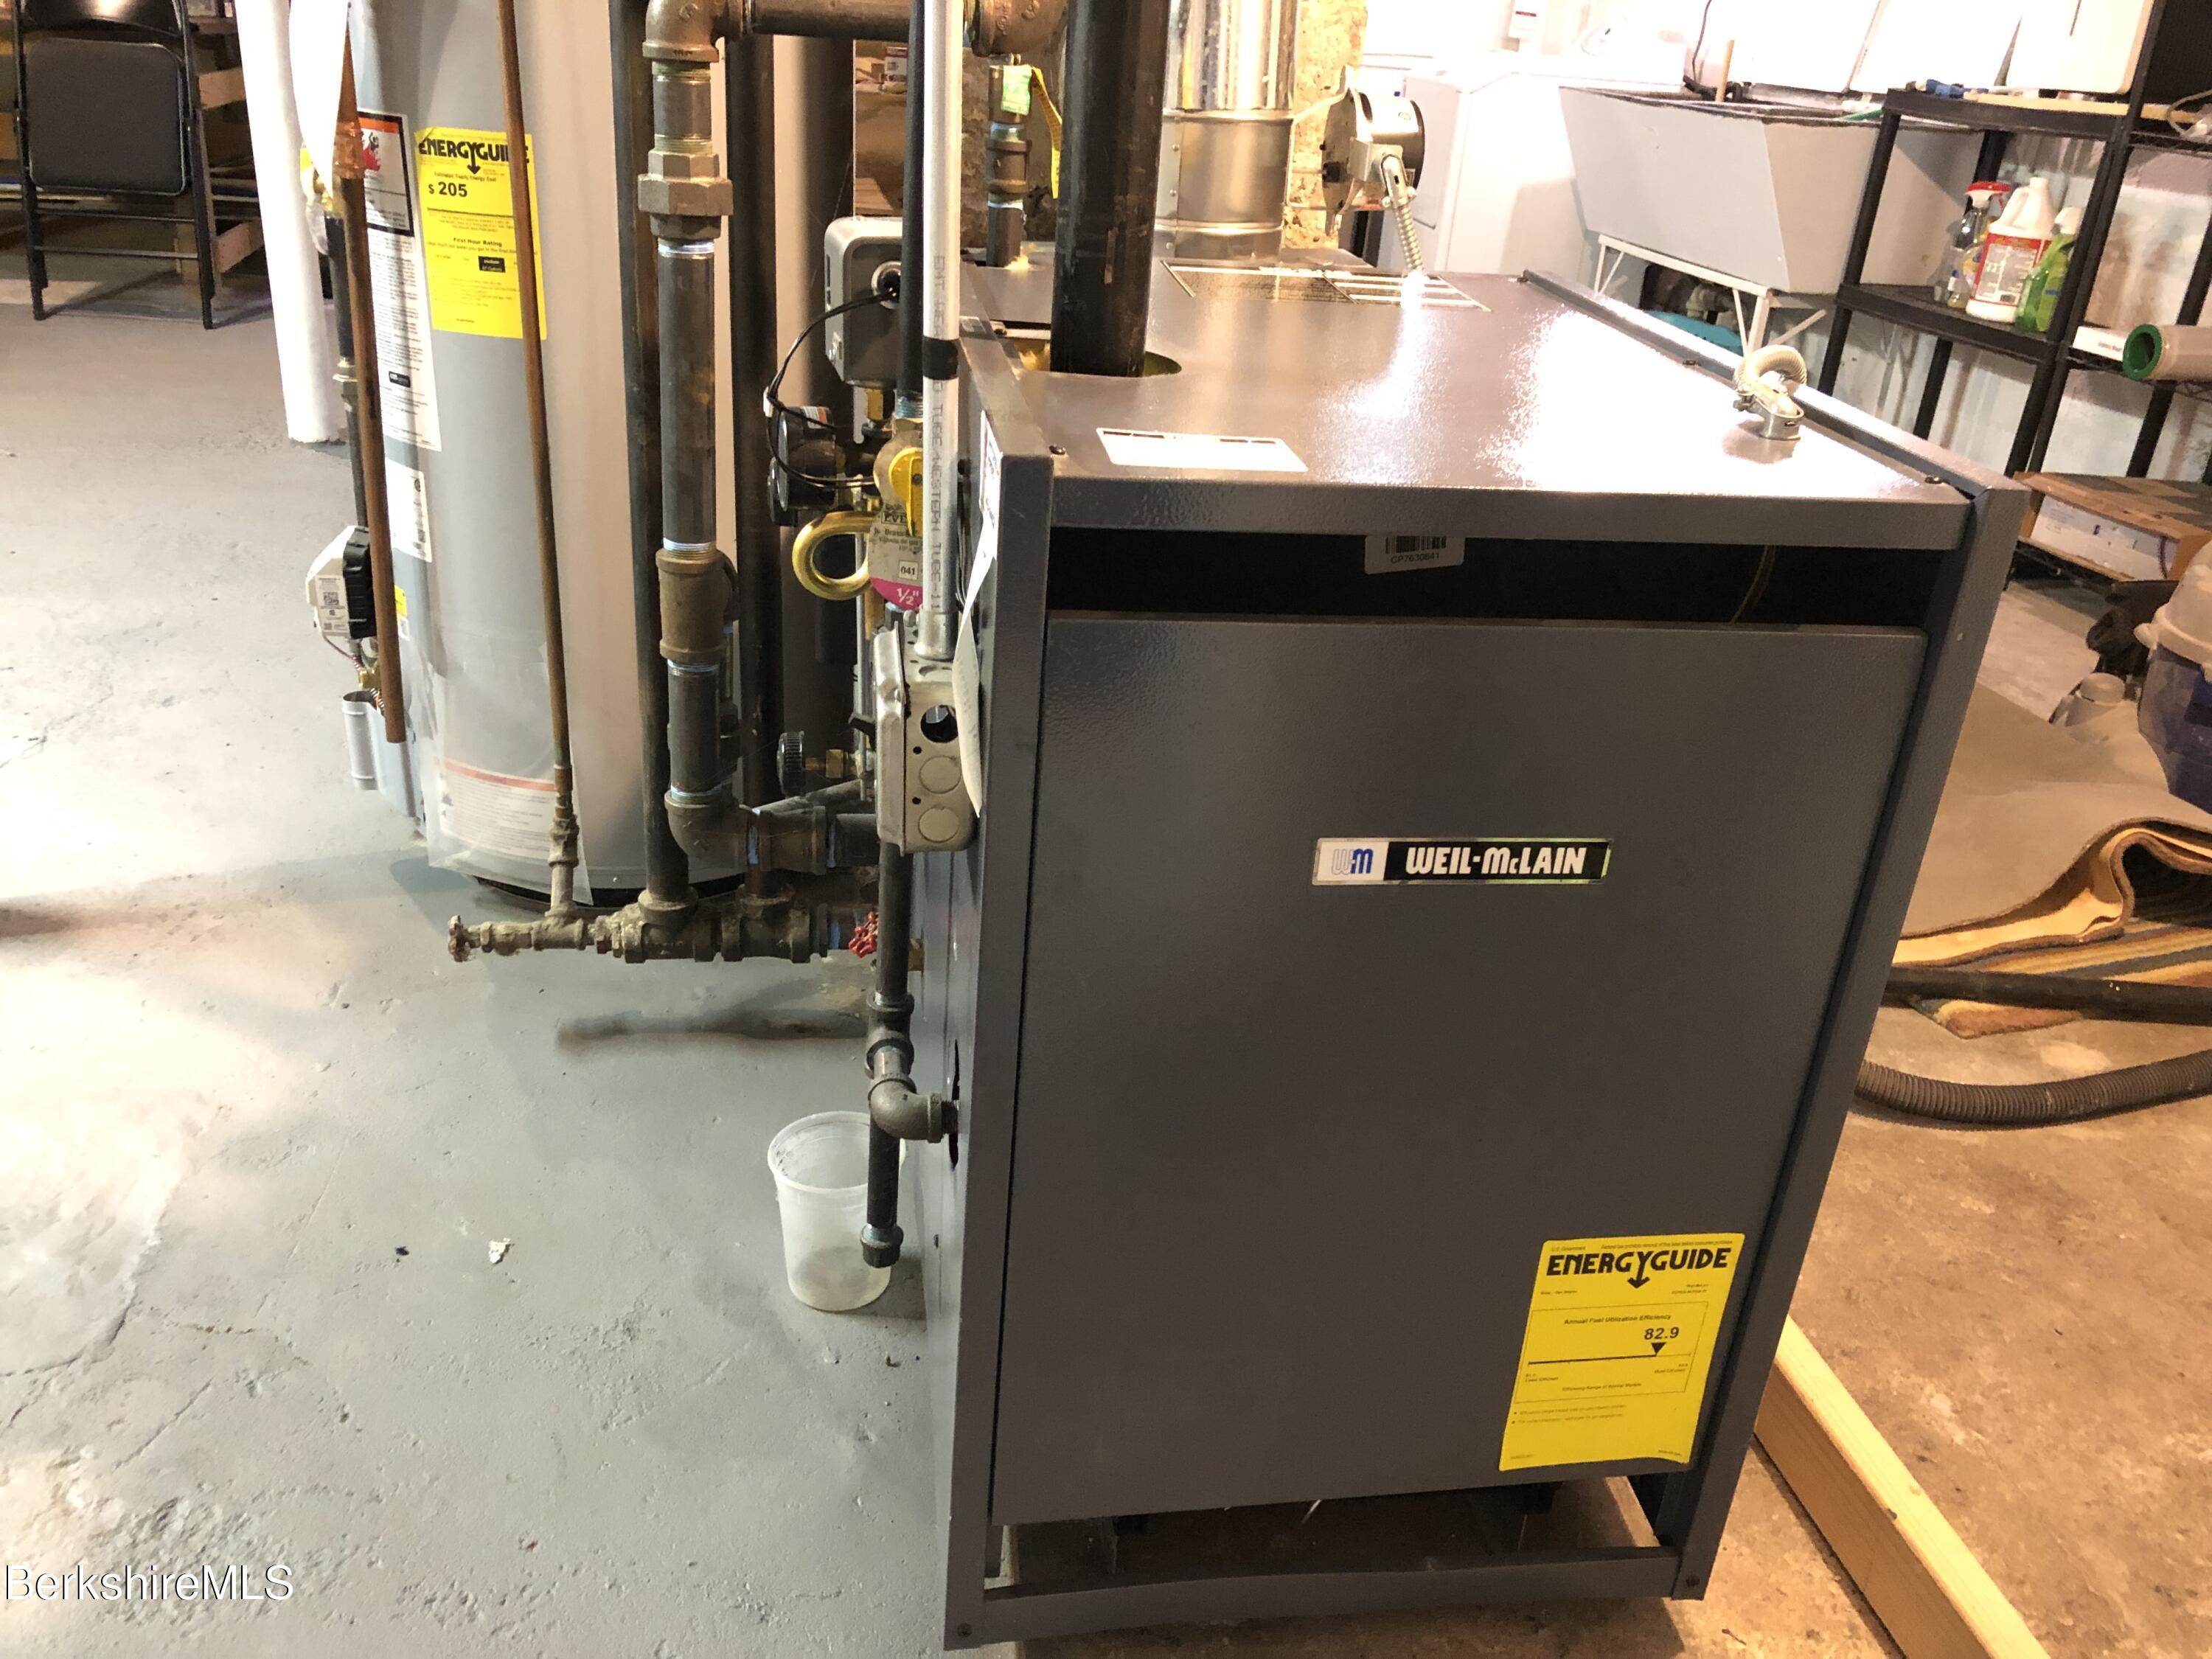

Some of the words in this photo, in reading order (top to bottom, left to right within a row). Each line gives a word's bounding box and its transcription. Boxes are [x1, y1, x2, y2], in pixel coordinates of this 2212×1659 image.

[418, 137, 529, 164] ENERGYGUIE
[438, 181, 467, 198] 205
[901, 566, 915, 575] 041
[1405, 846, 1587, 874] WEIL-McLAIN
[1546, 1247, 1731, 1278] ENERGYGUIDE
[1639, 1314, 1672, 1322] Efficiency
[1644, 1326, 1680, 1340] 82.9
